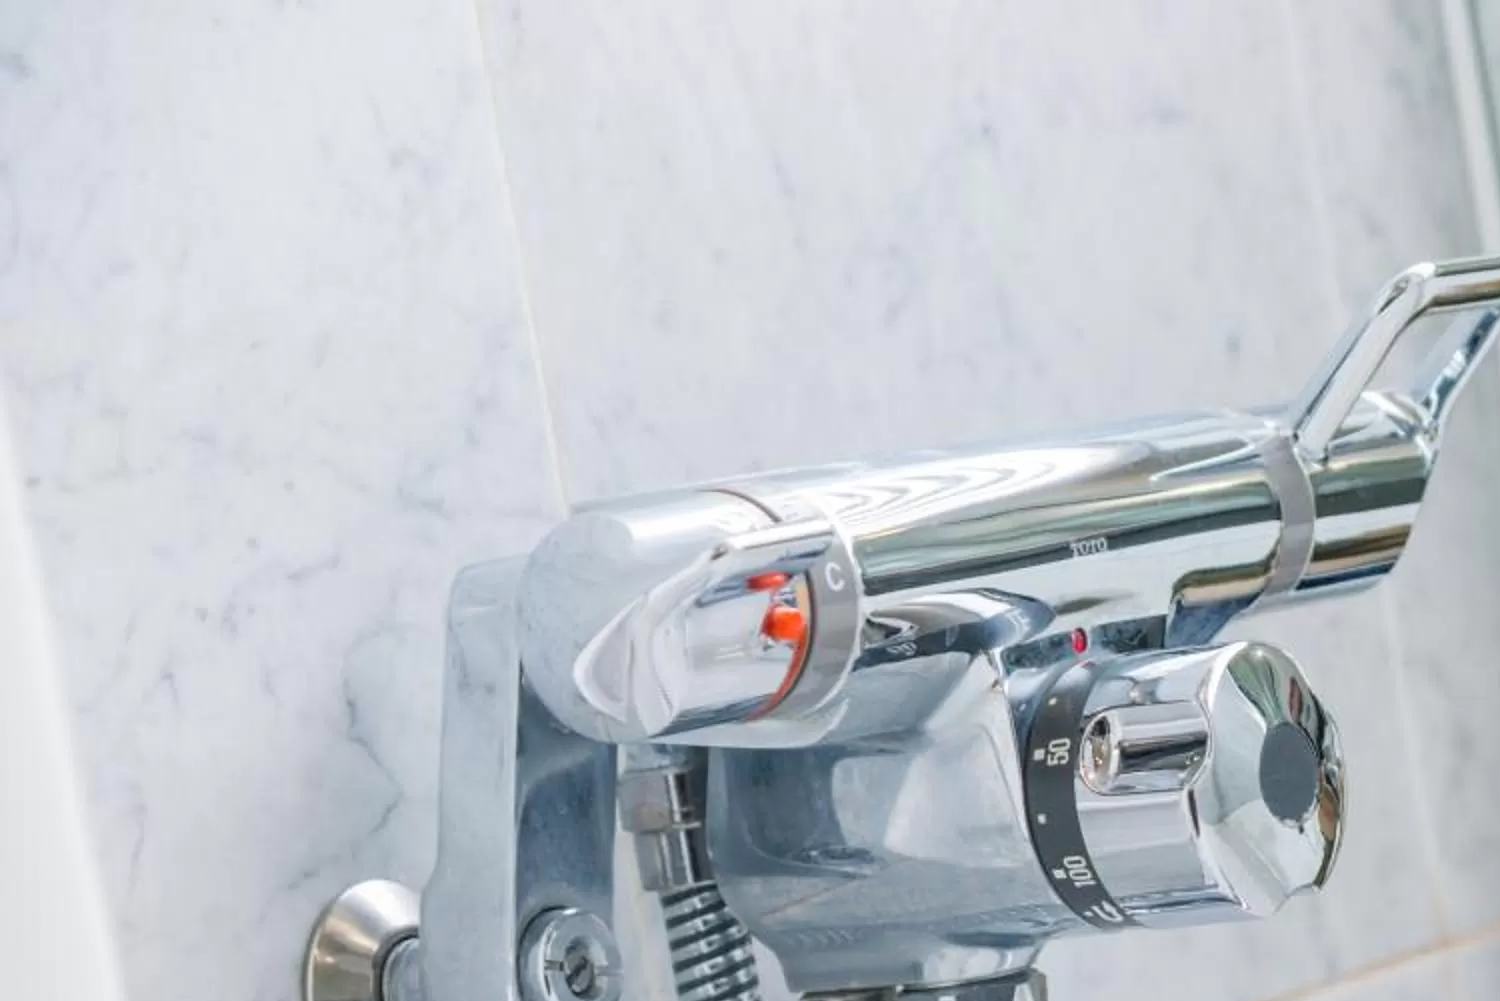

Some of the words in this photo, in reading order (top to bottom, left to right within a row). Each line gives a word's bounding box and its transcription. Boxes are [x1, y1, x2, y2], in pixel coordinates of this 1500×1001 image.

[1069, 537, 1108, 558] TOTO
[1047, 738, 1071, 766] 50
[1063, 855, 1096, 888] 100
